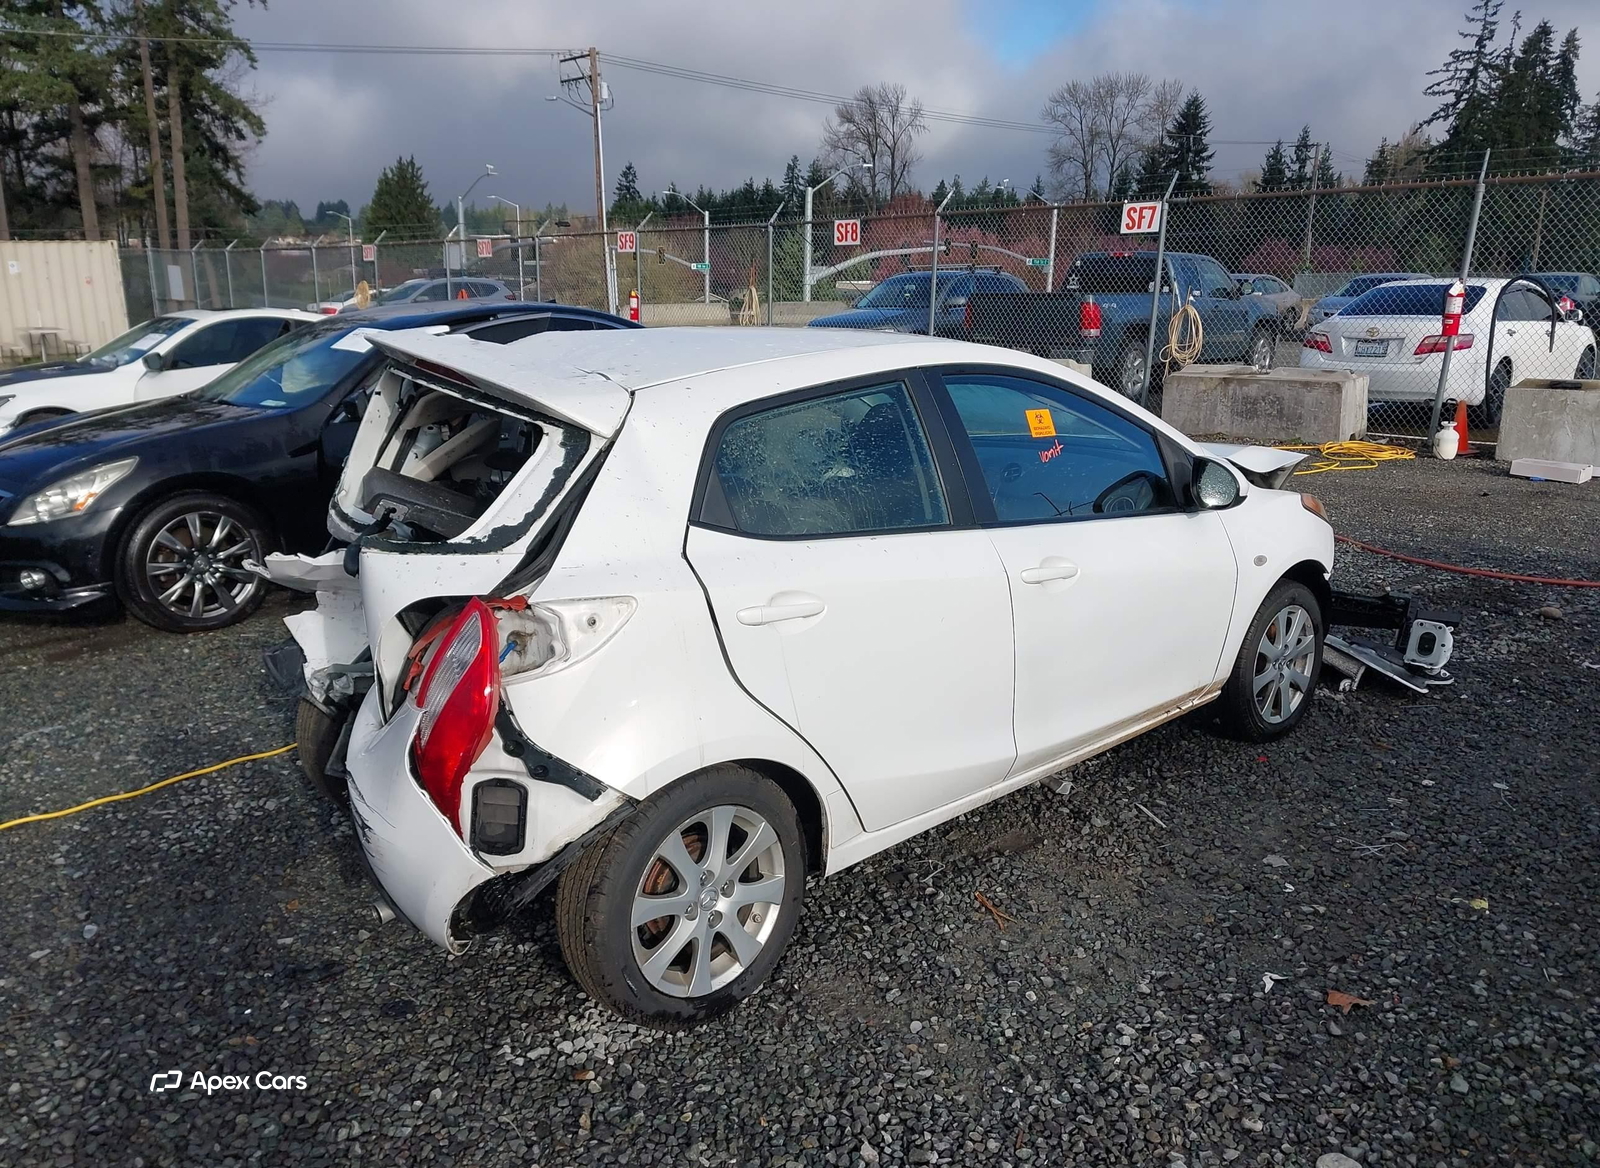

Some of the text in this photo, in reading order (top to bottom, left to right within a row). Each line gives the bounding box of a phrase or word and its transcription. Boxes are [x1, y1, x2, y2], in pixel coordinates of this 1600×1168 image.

[1125, 205, 1158, 231] SF7
[618, 232, 635, 250] SF9
[836, 222, 858, 242] SF8
